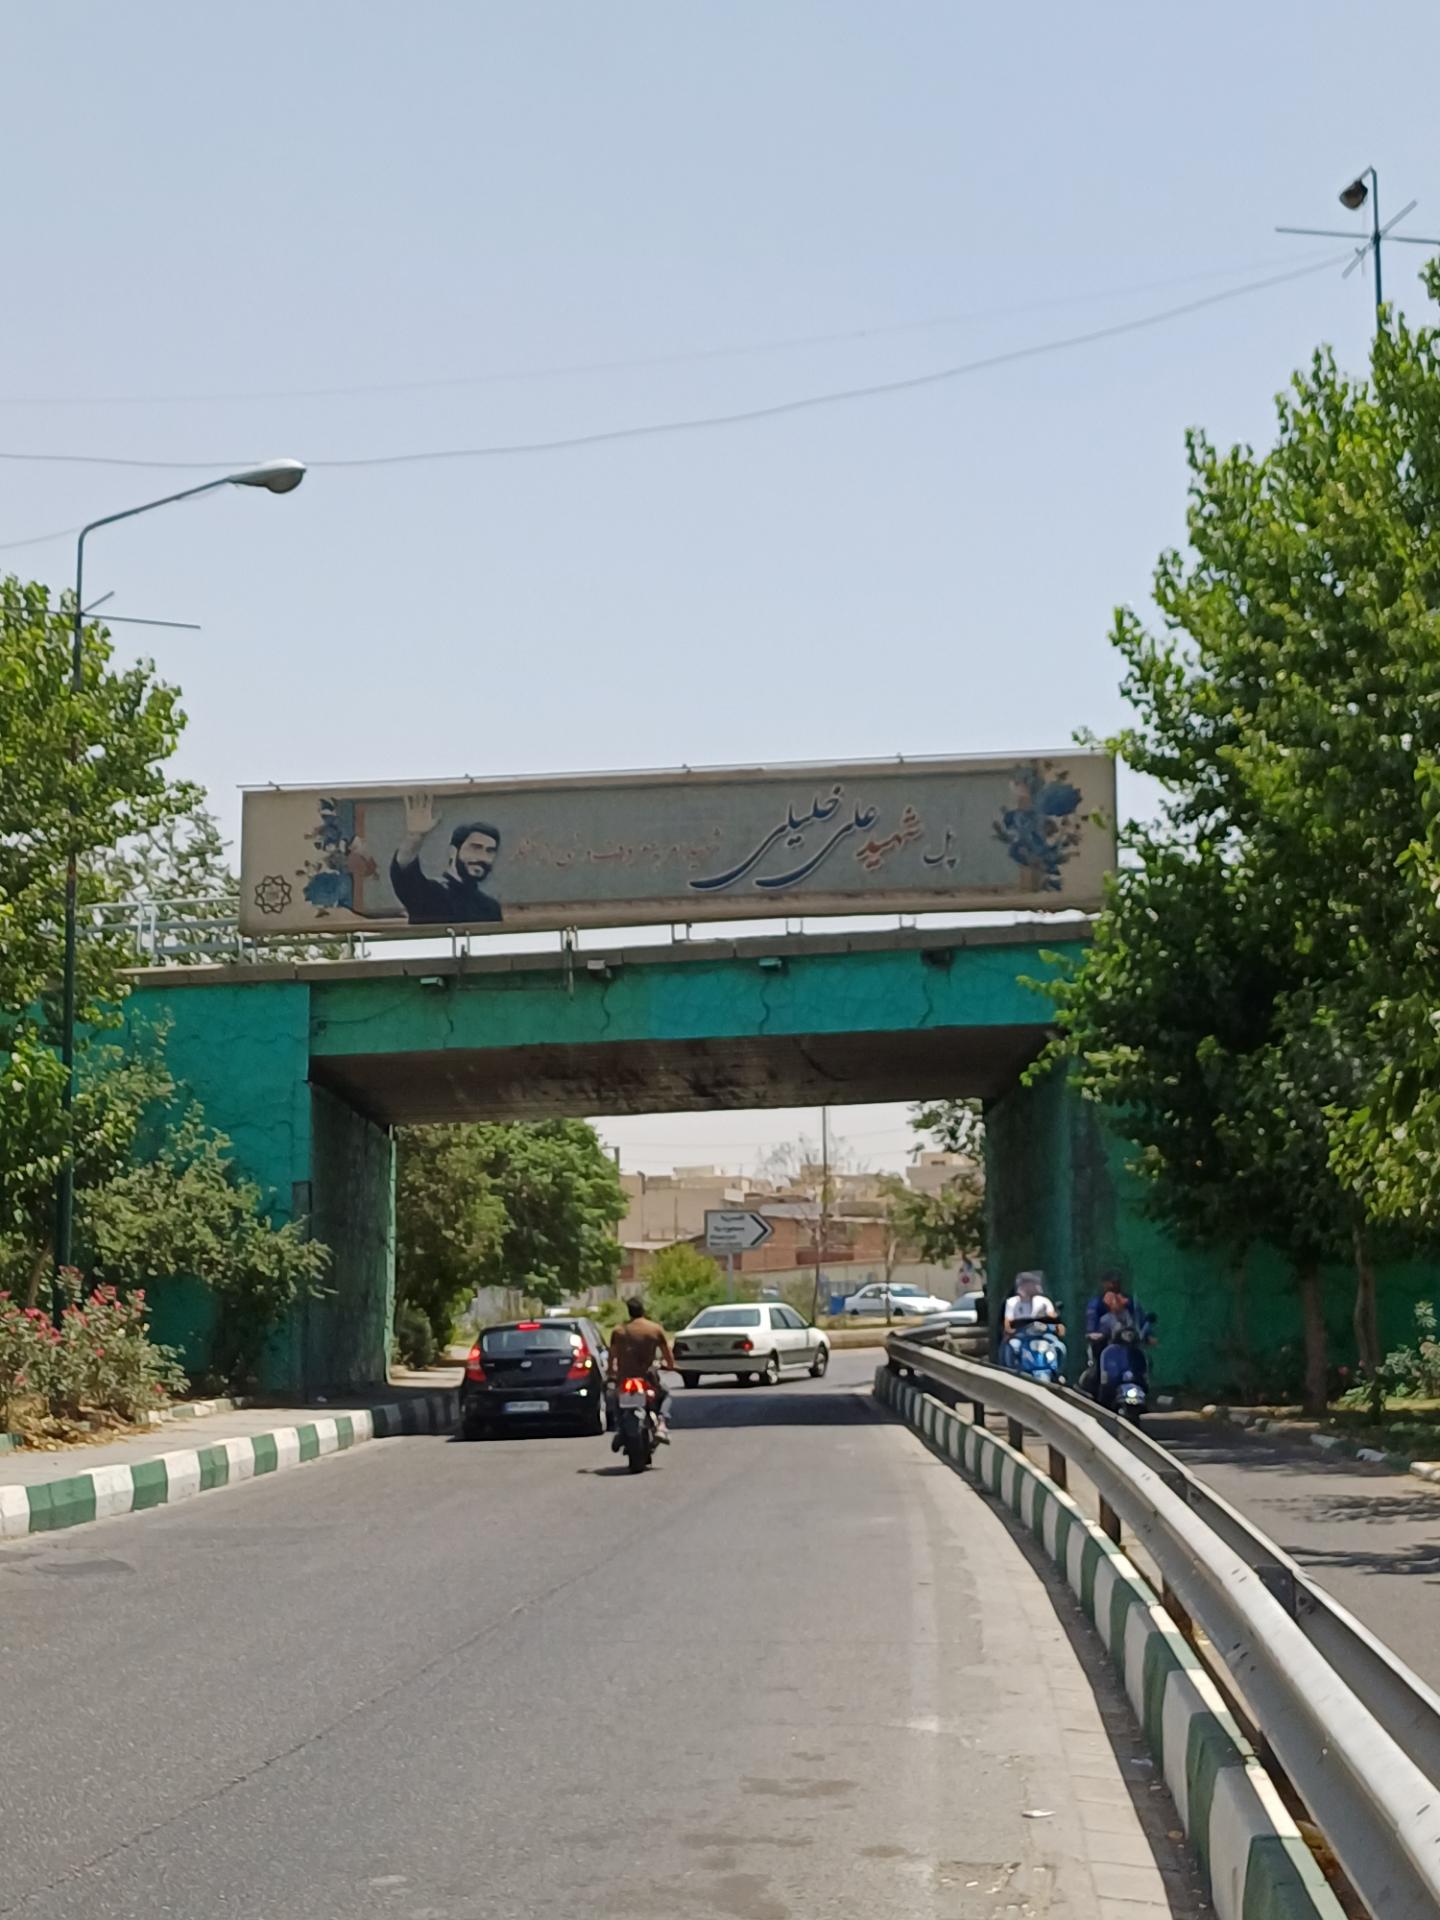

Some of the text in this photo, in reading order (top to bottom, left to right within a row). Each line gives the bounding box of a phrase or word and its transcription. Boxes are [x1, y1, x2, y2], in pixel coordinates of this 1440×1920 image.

[688, 784, 843, 890] خلیلی
[754, 800, 878, 889] علی
[856, 805, 924, 869] شهید
[923, 827, 957, 868] پل
